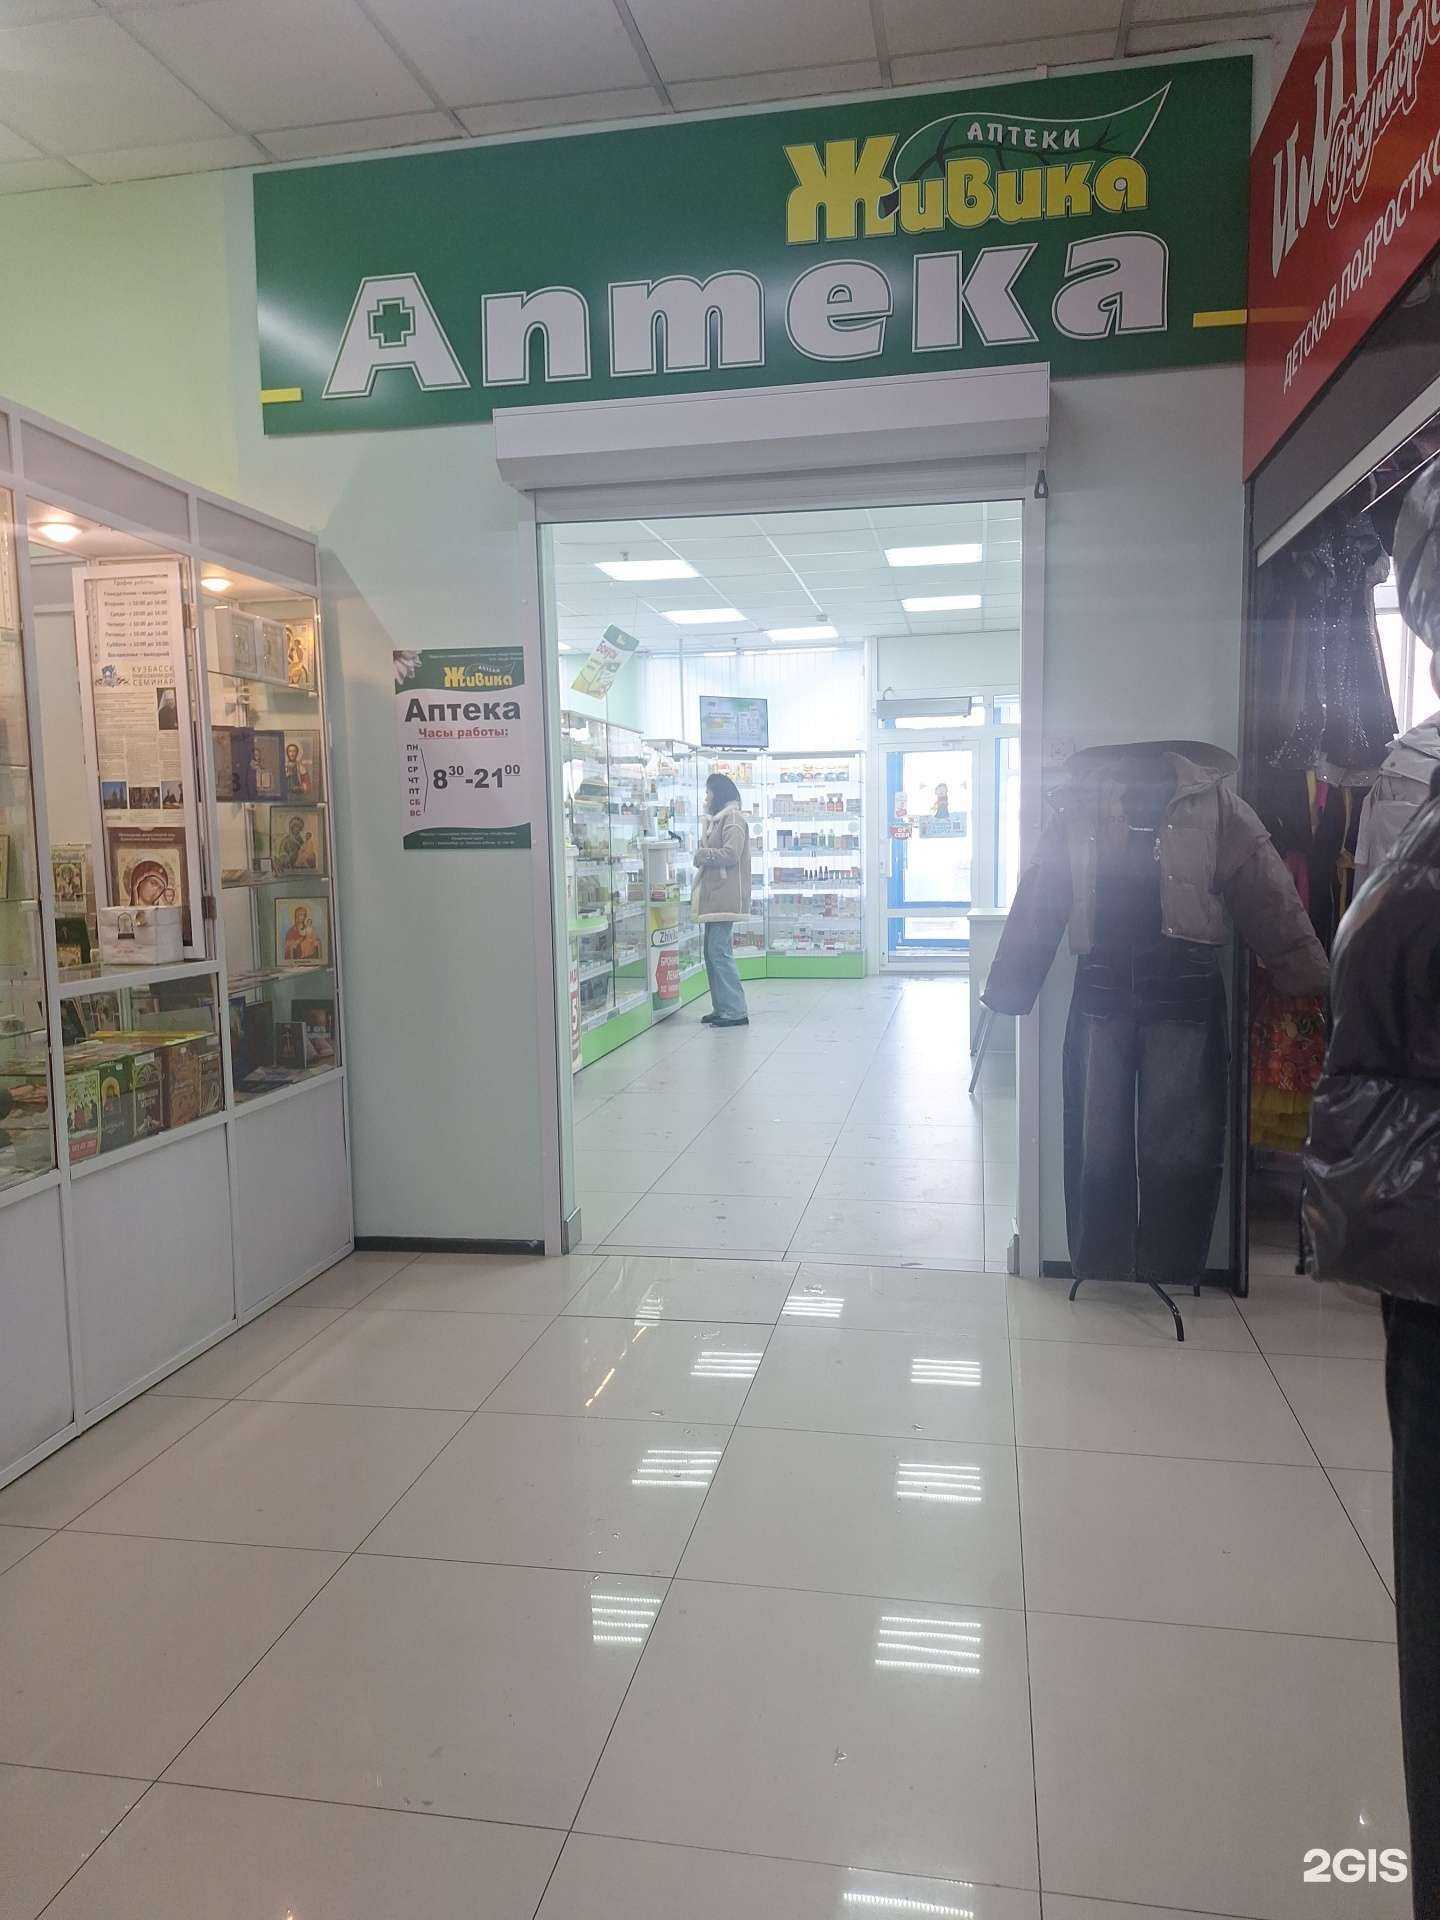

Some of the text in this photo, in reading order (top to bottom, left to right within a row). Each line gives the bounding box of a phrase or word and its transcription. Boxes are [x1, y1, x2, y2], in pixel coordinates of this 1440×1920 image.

[966, 120, 1081, 150] АПТЕКИ
[783, 133, 1149, 246] Живика
[322, 230, 1170, 400] Аптека
[1283, 283, 1337, 395] ДЕТСКАЯ
[443, 666, 513, 688] Живика
[404, 698, 521, 723] Аптека
[418, 726, 509, 740] Часы работы:
